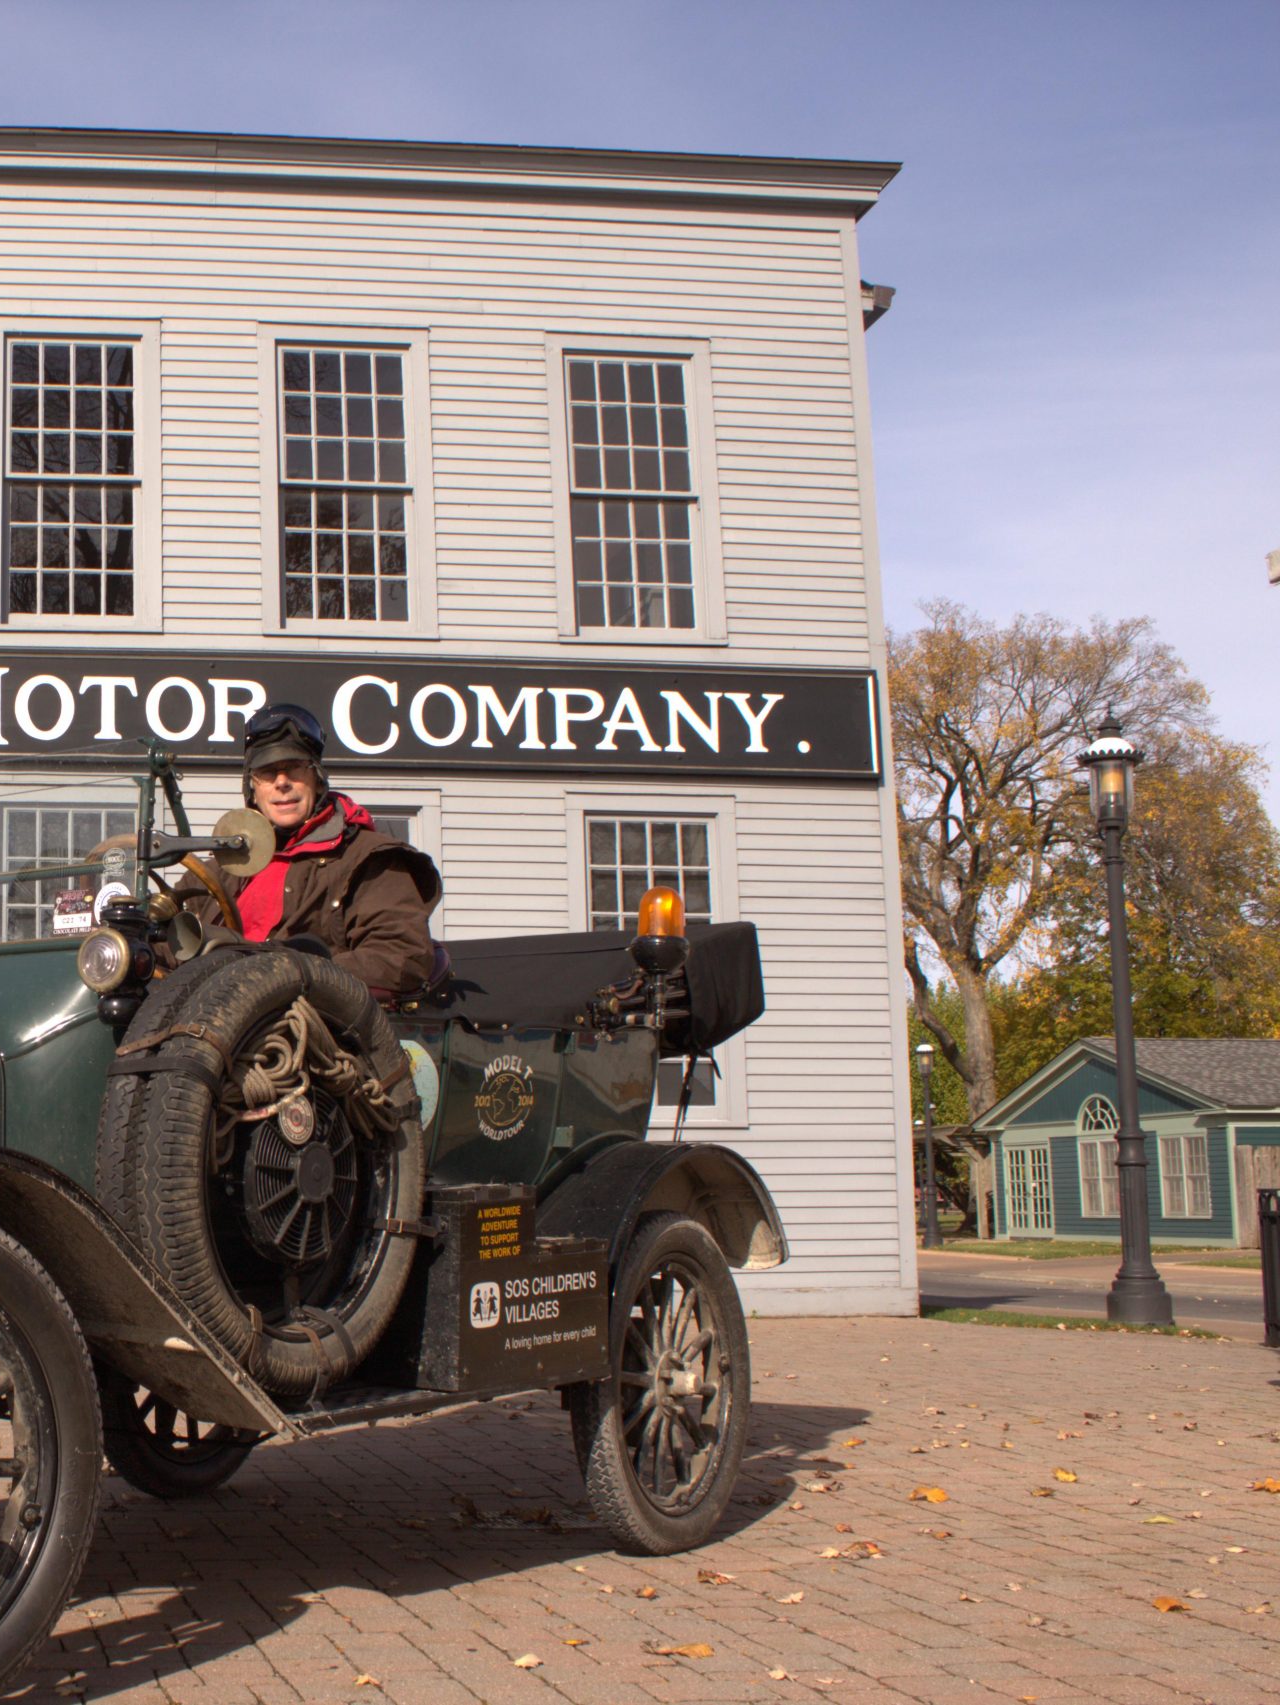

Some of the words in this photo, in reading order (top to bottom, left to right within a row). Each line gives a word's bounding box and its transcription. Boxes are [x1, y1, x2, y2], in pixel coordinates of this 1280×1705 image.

[484, 1055, 522, 1083] MODEL
[524, 1065, 534, 1080] T
[483, 1206, 521, 1218] WORLDWIDE
[481, 1219, 518, 1232] ADVENTURE
[480, 1235, 489, 1246] TO
[490, 1232, 519, 1245] SUPPORT
[479, 1249, 491, 1260] THE
[492, 1246, 511, 1258] WORK
[512, 1245, 521, 1256] OF
[505, 1279, 529, 1298] SOS
[532, 1271, 596, 1295] CHILDREN'S
[505, 1300, 559, 1324] VILLAGES
[504, 1337, 511, 1350] A
[511, 1335, 532, 1350] loving
[533, 1333, 552, 1346] home
[552, 1331, 562, 1343] for
[563, 1330, 580, 1342] every
[581, 1325, 597, 1338] child
